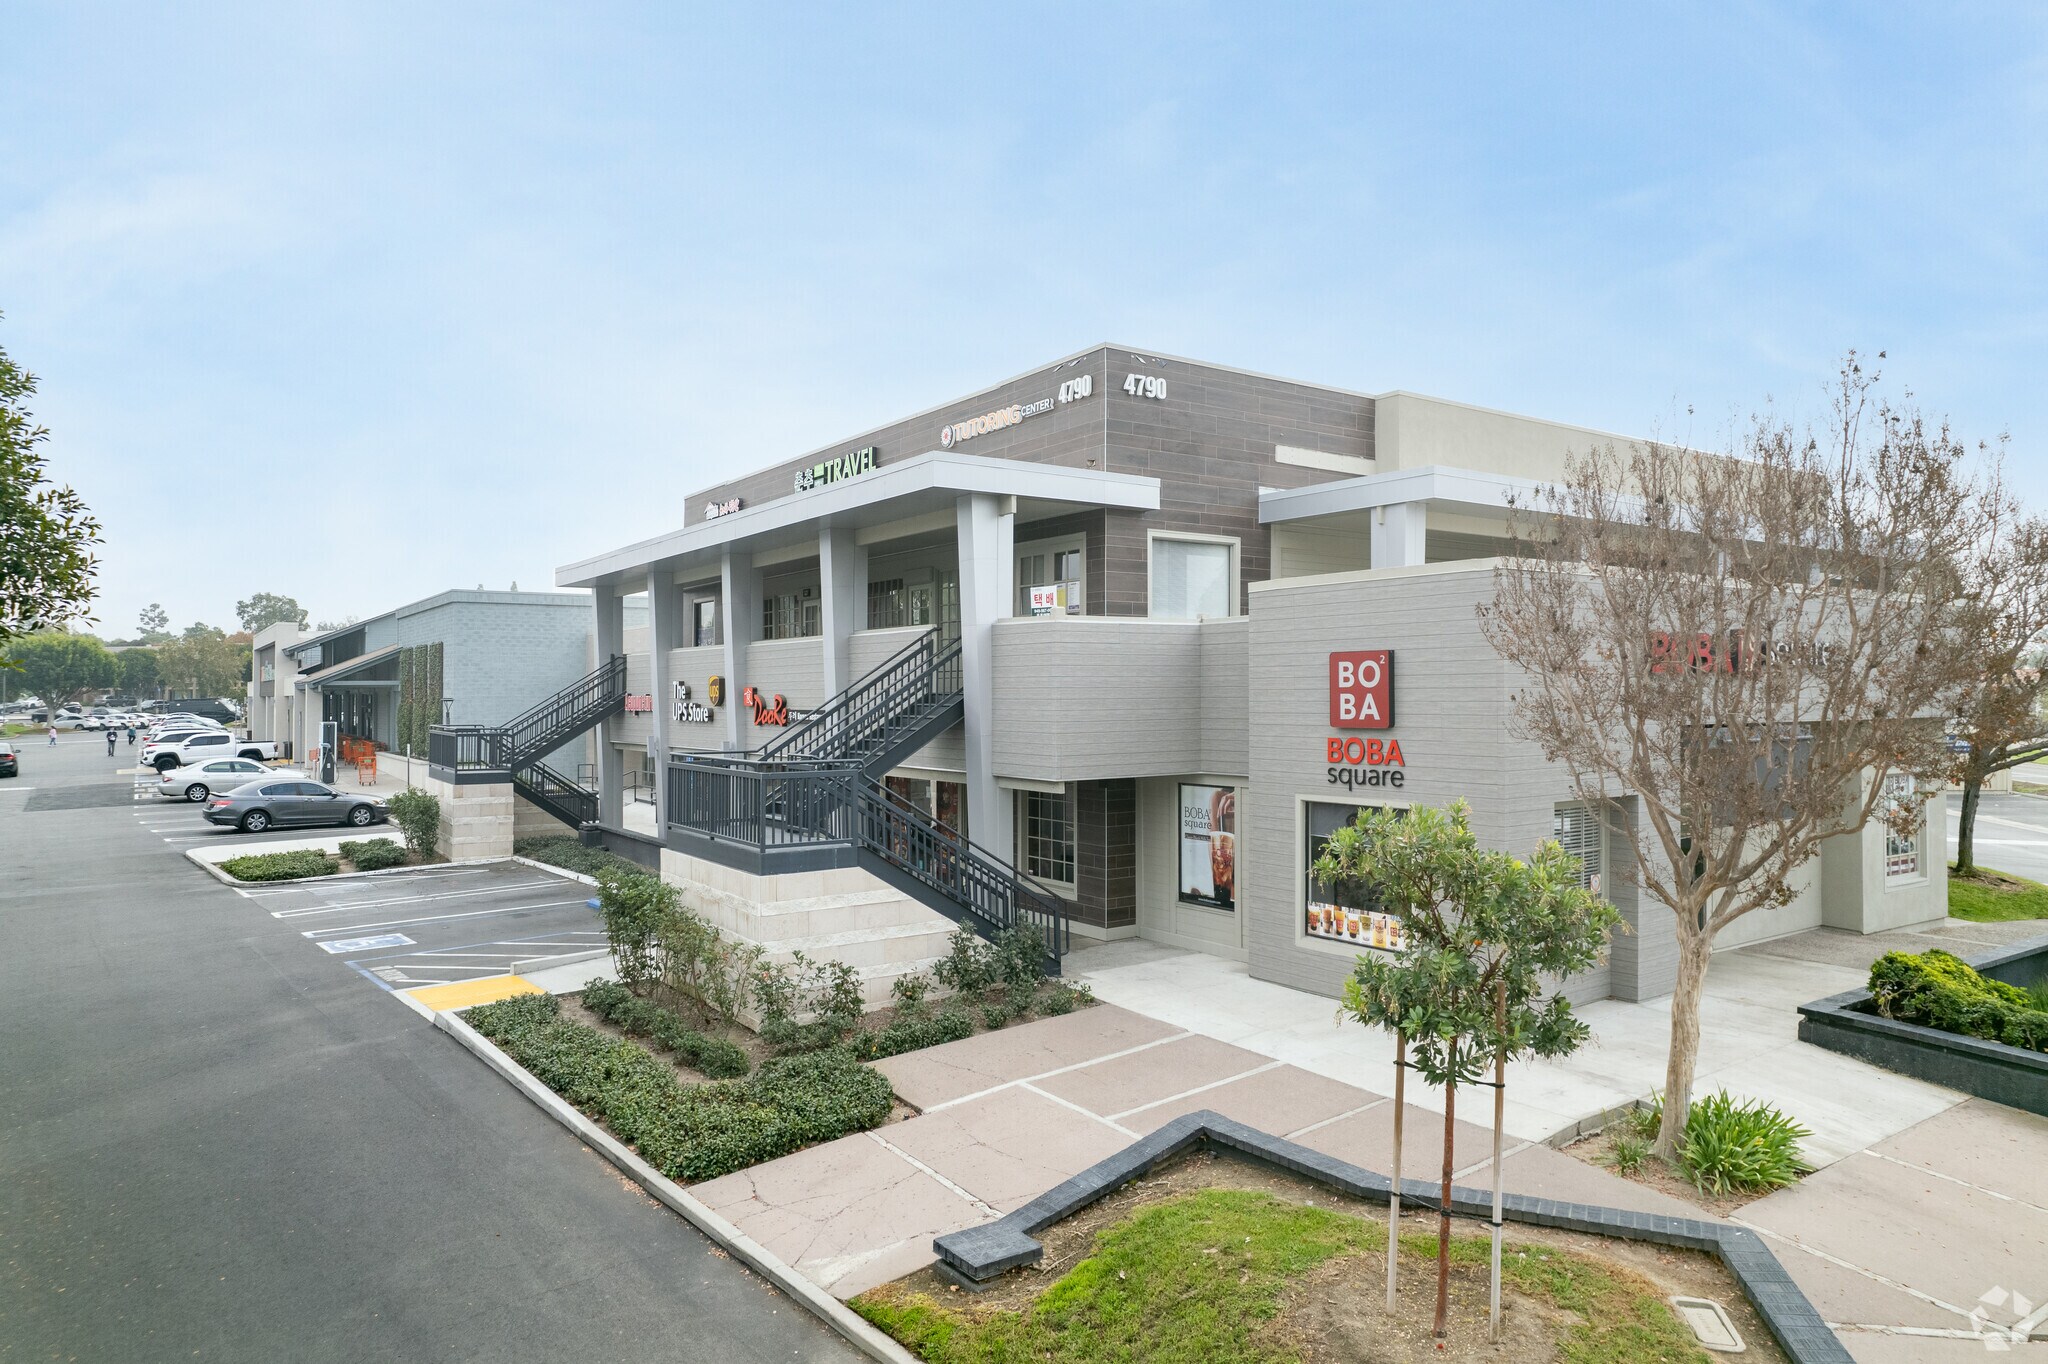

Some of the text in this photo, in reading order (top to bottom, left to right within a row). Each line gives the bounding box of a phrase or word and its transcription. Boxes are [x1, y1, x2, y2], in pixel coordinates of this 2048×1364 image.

[1058, 374, 1092, 403] 4790
[1123, 373, 1167, 400] 4790
[954, 398, 1050, 441] TUTORING CENTER
[825, 446, 877, 486] TRAVEL
[672, 681, 686, 700] The
[709, 685, 719, 702] ups
[672, 703, 688, 722] UPS
[688, 703, 709, 723] Store
[1339, 693, 1381, 721] BA
[1327, 737, 1405, 767] BOBA
[1327, 767, 1405, 791] square
[1184, 806, 1211, 821] BOBA
[1184, 819, 1212, 830] square
